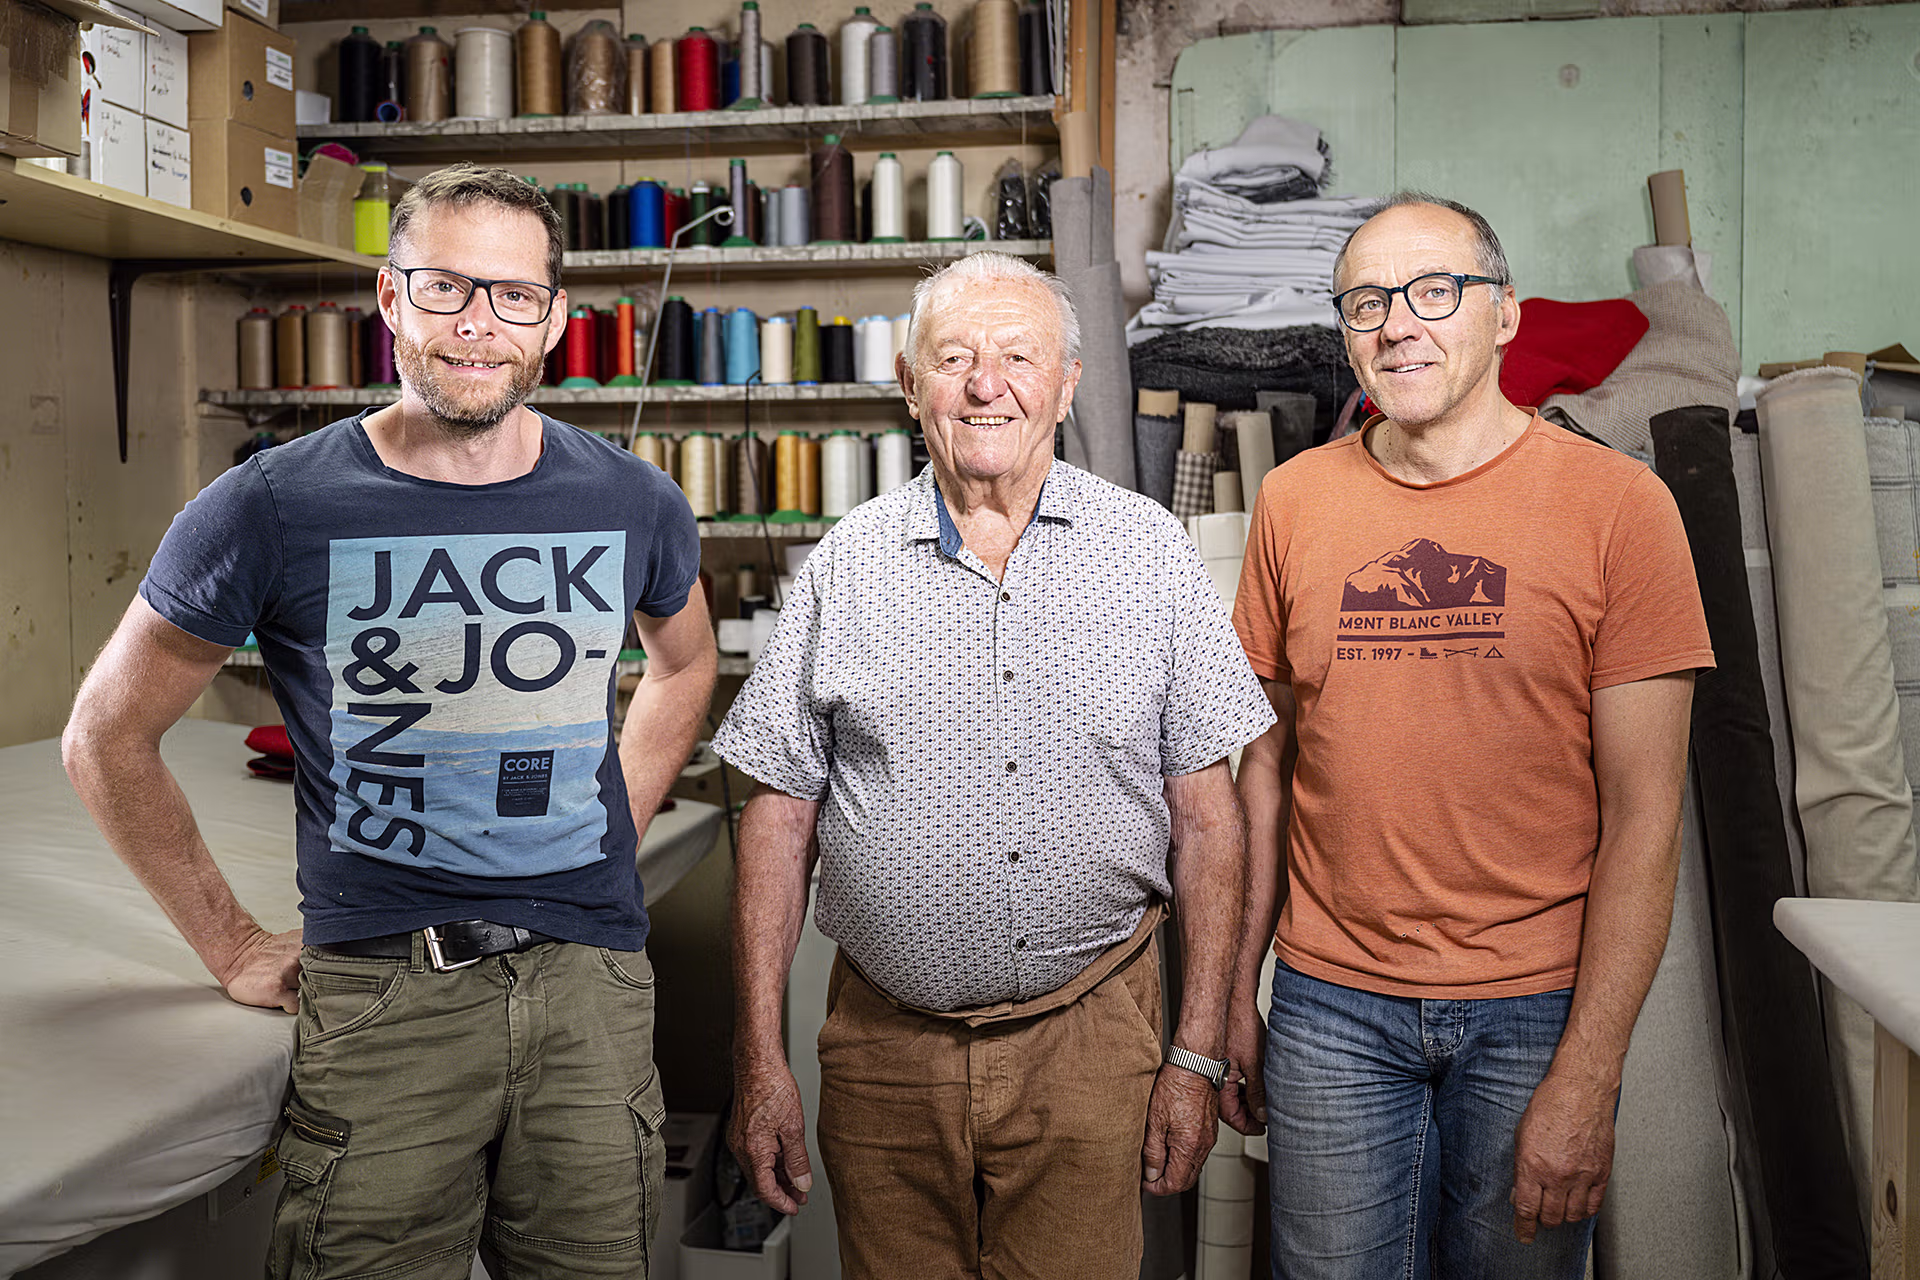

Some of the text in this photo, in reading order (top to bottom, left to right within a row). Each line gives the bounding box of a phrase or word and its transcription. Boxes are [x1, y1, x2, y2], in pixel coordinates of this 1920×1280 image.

[346, 545, 614, 621] JACK
[1338, 613, 1503, 630] MONT BLANC VALLEY
[1336, 647, 1367, 661] EST.
[1371, 647, 1402, 661] 1997
[504, 757, 550, 771] CORE
[345, 702, 432, 857] NES
